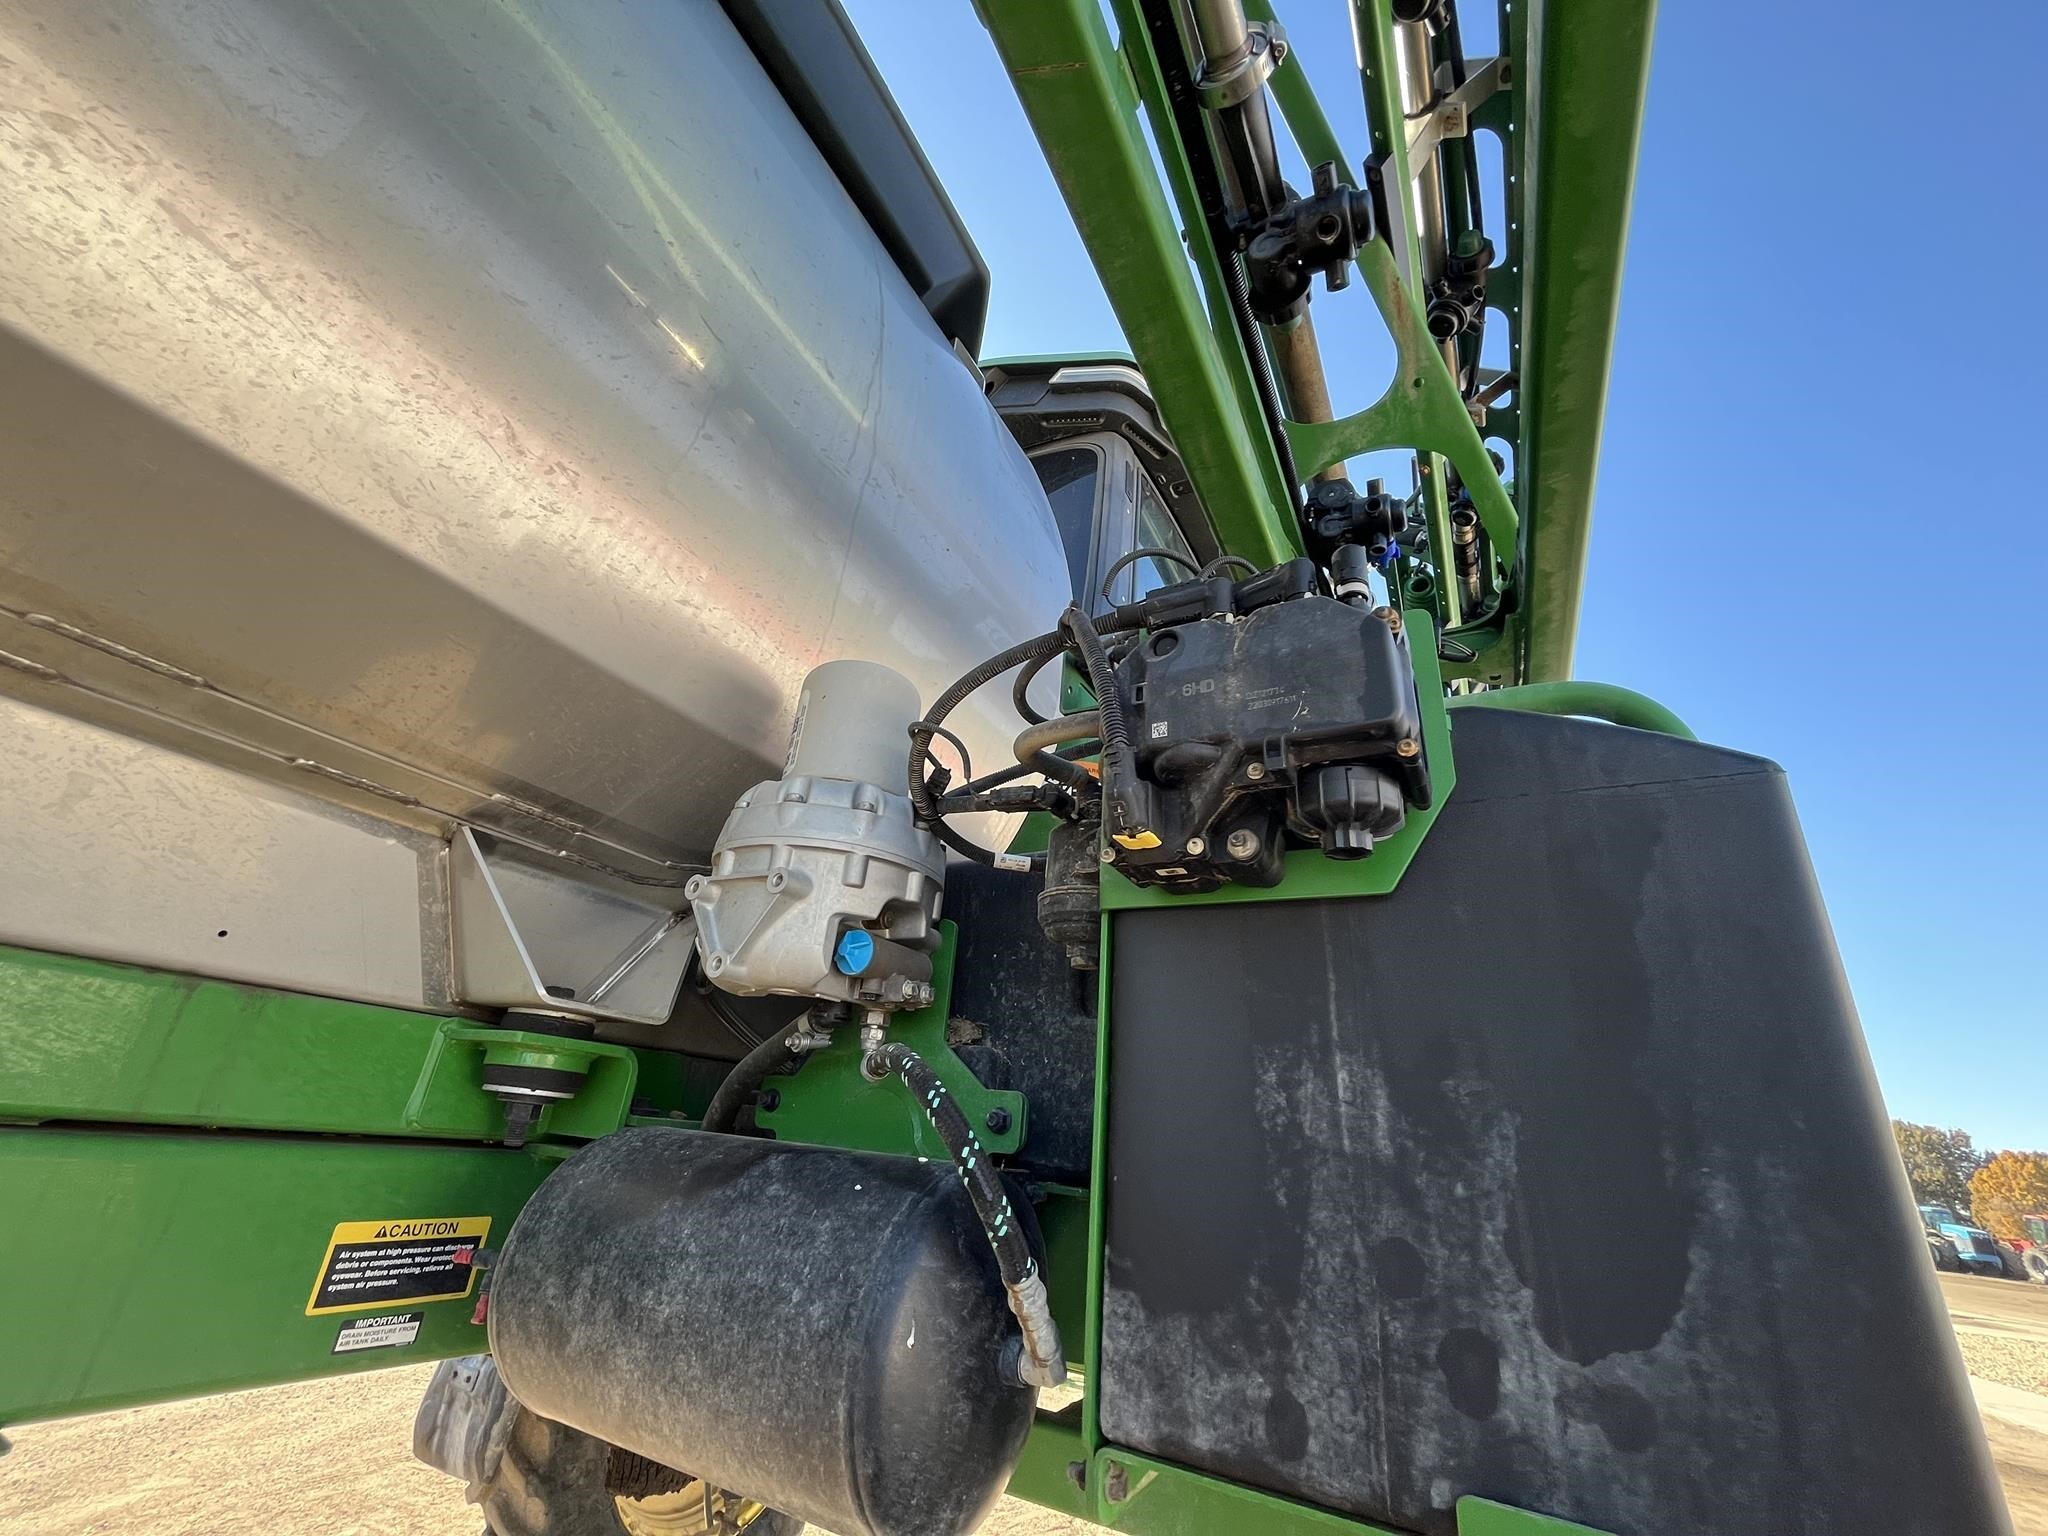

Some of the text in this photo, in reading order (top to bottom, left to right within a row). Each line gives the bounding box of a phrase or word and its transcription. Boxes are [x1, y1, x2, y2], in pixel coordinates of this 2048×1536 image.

[1182, 679, 1215, 696] 6HD
[389, 1222, 460, 1237] CAUTION
[339, 1250, 351, 1259] Air
[351, 1250, 378, 1259] system
[378, 1248, 386, 1256] at
[386, 1247, 402, 1257] high
[402, 1246, 432, 1255] pressure
[335, 1260, 360, 1270] debris
[369, 1257, 413, 1267] components.
[414, 1255, 431, 1263] Wear
[331, 1272, 363, 1281] eyewear.
[364, 1269, 389, 1278] Before
[422, 1264, 445, 1272] relieve
[327, 1279, 398, 1292] system air pressure.
[354, 1314, 412, 1329] IMPORTANT
[341, 1331, 363, 1340] DRAIN
[363, 1327, 397, 1337] MOISTURE
[339, 1335, 389, 1348] AIR TANK DAILY
